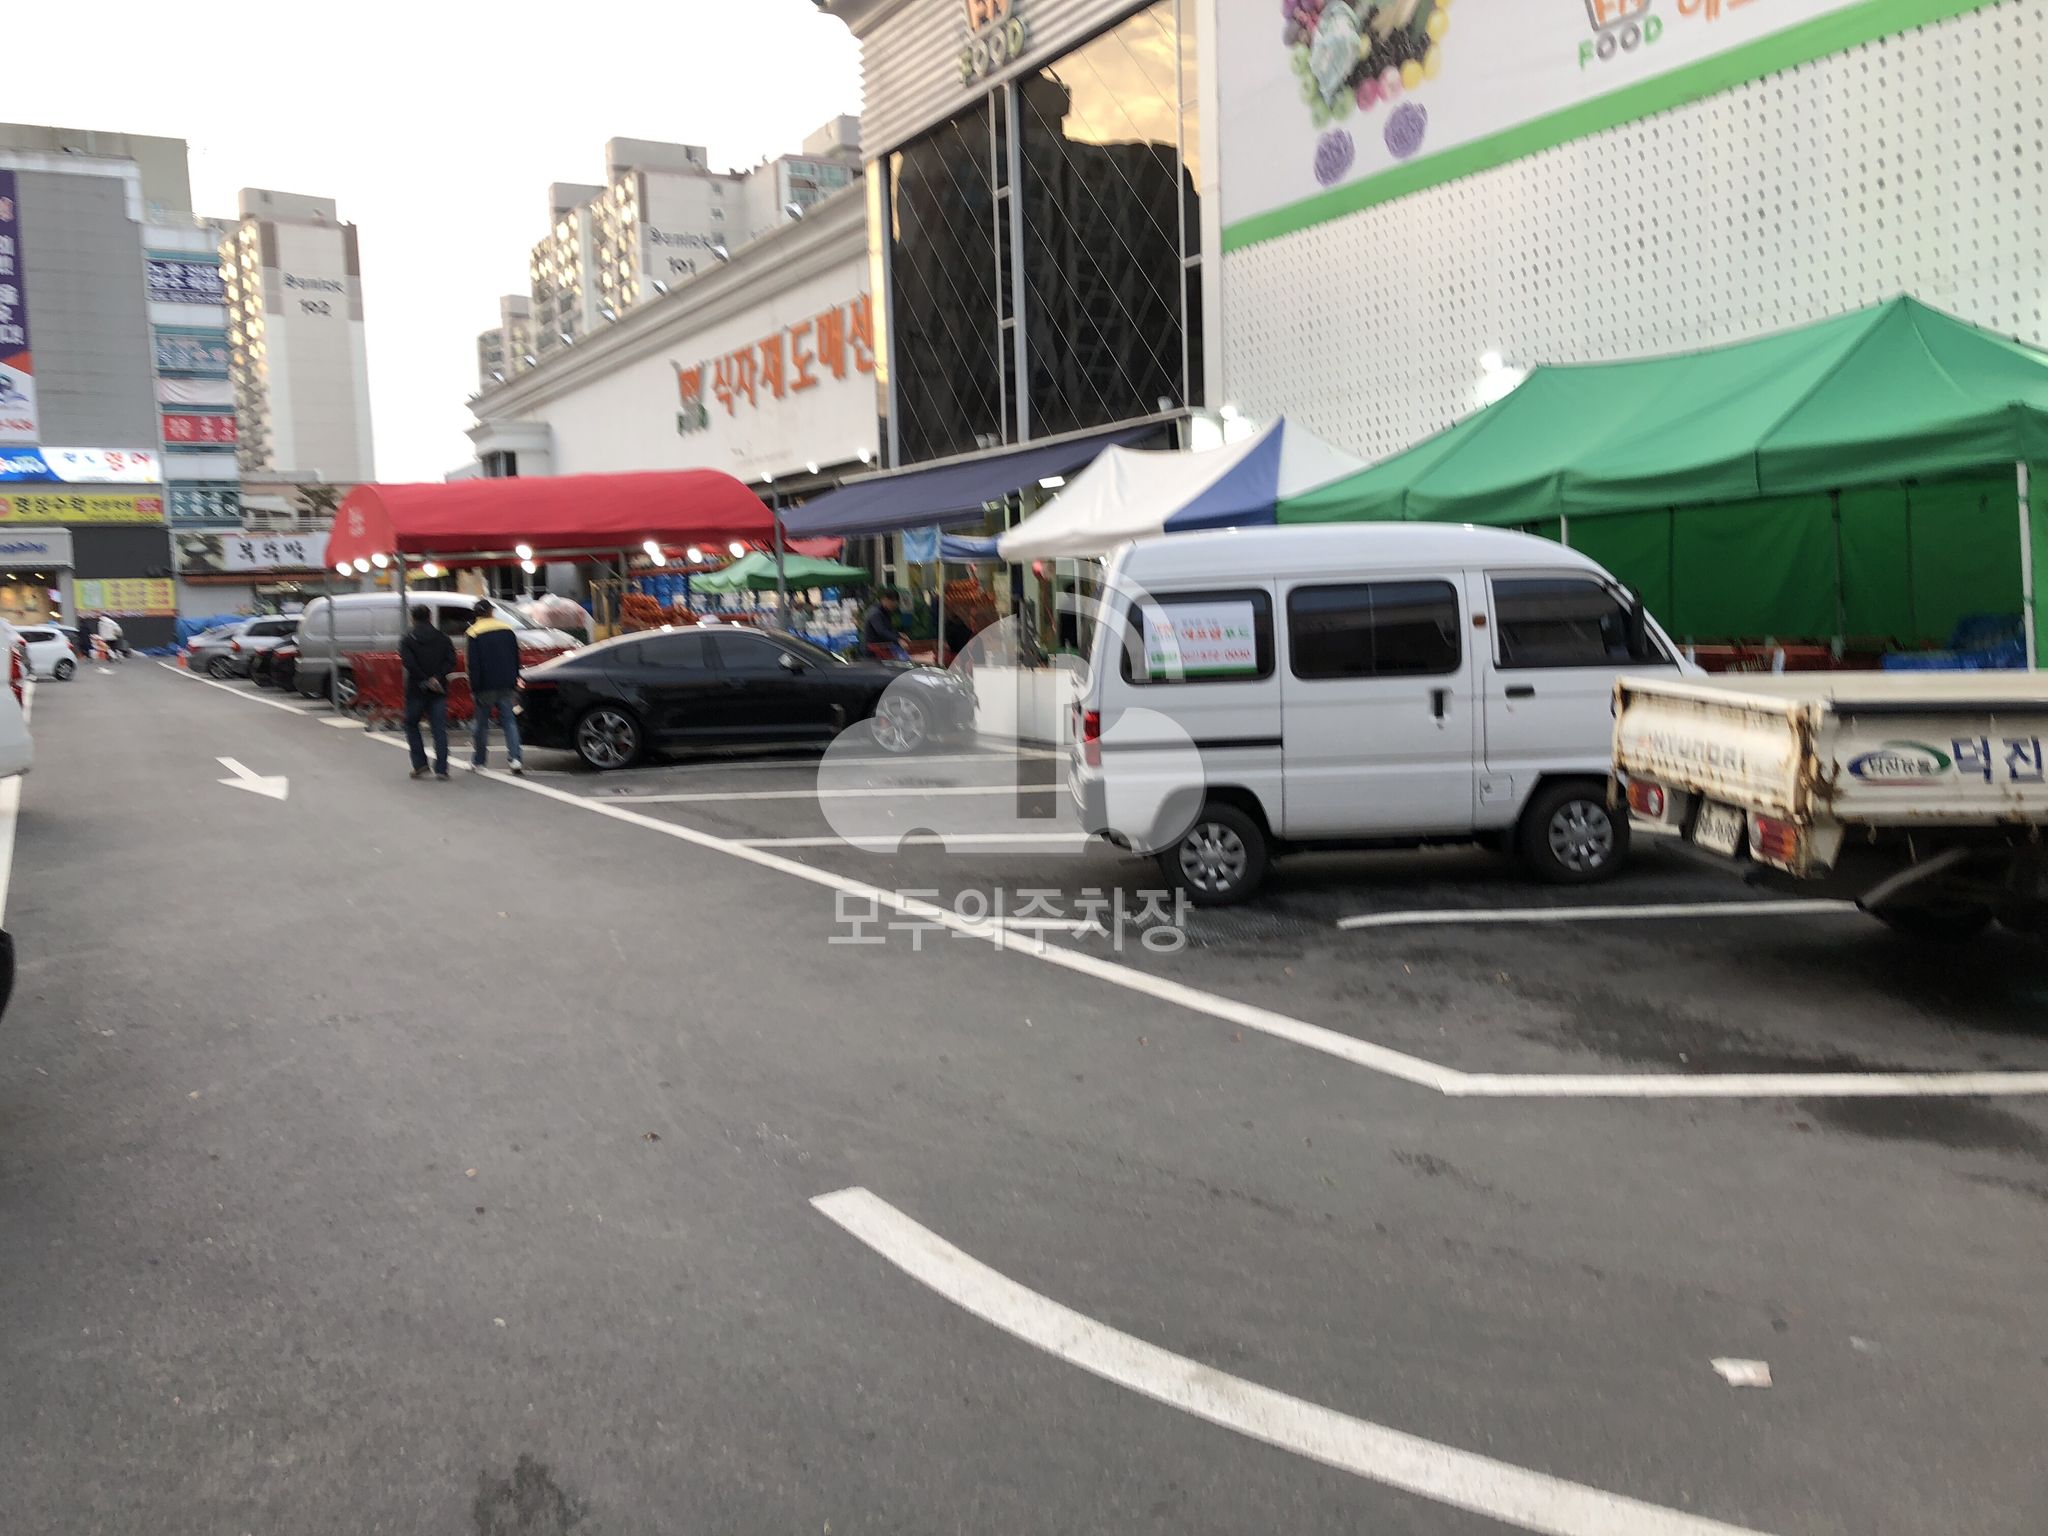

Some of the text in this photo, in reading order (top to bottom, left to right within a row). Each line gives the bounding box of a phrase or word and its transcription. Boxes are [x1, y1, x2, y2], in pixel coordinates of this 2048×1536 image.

[959, 18, 1025, 87] FOOD
[1578, 15, 1664, 70] FOOD
[299, 299, 332, 317] 102
[1950, 735, 2046, 785] 덕진
